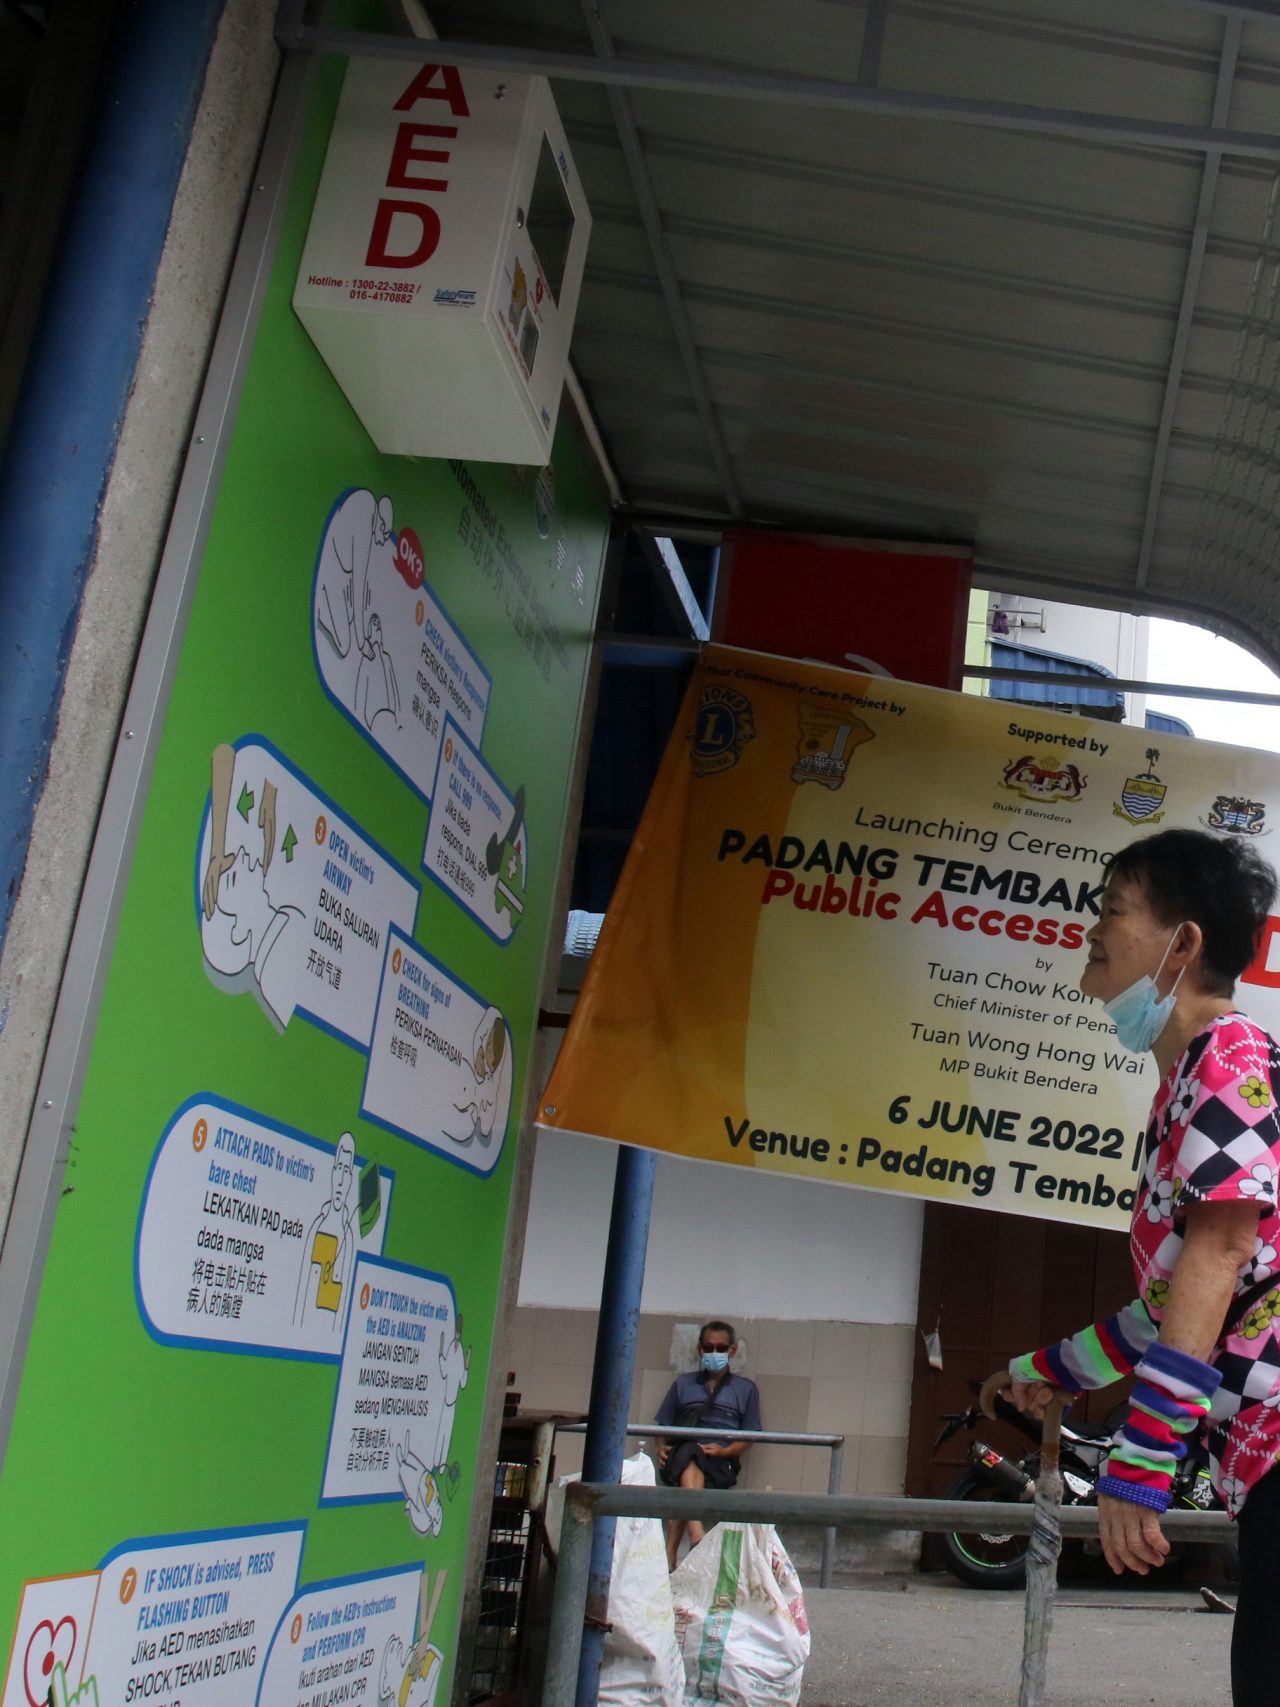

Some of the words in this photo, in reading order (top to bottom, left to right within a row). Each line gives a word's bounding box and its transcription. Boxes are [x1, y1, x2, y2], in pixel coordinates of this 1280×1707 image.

[365, 63, 471, 269] AED
[308, 275, 343, 287] Hotline
[400, 536, 423, 579] OK?
[425, 618, 445, 657] CHECK
[421, 642, 448, 687] PERIKSA
[416, 670, 441, 709] mangsa
[735, 667, 807, 693] Community
[809, 686, 840, 700] Care
[841, 692, 888, 712] Project
[889, 702, 906, 717] by
[1008, 723, 1086, 750] Supported
[1090, 738, 1109, 757] by
[449, 772, 462, 801] CALL
[462, 786, 472, 811] 999
[992, 802, 1022, 815] Bukit
[1024, 808, 1072, 825] Bendera
[854, 806, 1000, 853] Launching
[1007, 830, 1116, 867] Ceremo
[329, 830, 350, 862] OPEN
[350, 851, 375, 885] victim's
[464, 844, 477, 872] DIAL
[717, 828, 900, 881] PADANG
[912, 853, 1102, 917] TEMBAK
[323, 859, 353, 896] AIRWAY
[319, 888, 342, 922] BUKA
[343, 908, 380, 950] SALURAN
[761, 868, 902, 920] Public
[911, 890, 1086, 950] Access
[314, 916, 343, 953] UDARA
[306, 948, 342, 990] 开放气道
[402, 958, 422, 986] CHECK
[422, 973, 430, 992] for
[430, 981, 445, 1005] signs
[445, 993, 452, 1009] of
[927, 962, 978, 986] Tuan
[984, 972, 1048, 999] Chow
[1036, 957, 1054, 974] by
[398, 983, 430, 1020] BREATHING
[932, 993, 978, 1012] Chief
[980, 1000, 1050, 1025] Minister
[1053, 1011, 1072, 1027] of
[1076, 1015, 1118, 1036] Pena
[395, 1007, 422, 1039] PERIKSA
[423, 1028, 462, 1067] PERNAFASAN
[910, 1022, 962, 1047] Tuan
[967, 1030, 1032, 1061] Wong
[1036, 1041, 1097, 1072] Hong
[1102, 1052, 1146, 1076] Wai
[939, 1058, 970, 1076] MP
[974, 1062, 1020, 1084] Bukit
[1024, 1070, 1099, 1096] Bendera
[888, 1095, 912, 1125] 6
[918, 1099, 1022, 1143] JUNE
[1026, 1116, 1125, 1160] 2022
[214, 1126, 250, 1156] ATTACH
[251, 1139, 274, 1166] PADS
[275, 1149, 284, 1171] to
[284, 1151, 315, 1182] victim's
[722, 1115, 831, 1163] Venue
[856, 1137, 997, 1197] Padang
[1008, 1160, 1138, 1213] Temba
[208, 1160, 230, 1188] bare
[232, 1168, 257, 1195] chest
[203, 1191, 259, 1227] LEKATKAN
[260, 1207, 280, 1232] PAD
[280, 1215, 303, 1239] pada
[197, 1225, 224, 1252] dada
[225, 1236, 264, 1264] mangsa
[191, 1257, 267, 1296] 将电击贴片贴在
[186, 1287, 243, 1319] 病人的胸膛
[370, 1288, 389, 1307] DON'T
[390, 1292, 409, 1313] TOUCH
[410, 1296, 418, 1313] the
[419, 1299, 435, 1318] victim
[366, 1317, 376, 1333] the
[377, 1319, 390, 1336] AED
[396, 1321, 426, 1342] ANALYZING
[362, 1340, 392, 1361] JANGAN
[392, 1343, 420, 1365] SENTUH
[358, 1368, 390, 1388] MANGSA
[390, 1373, 414, 1390] semasa
[414, 1374, 428, 1391] AED
[354, 1399, 380, 1419] sedang
[381, 1398, 428, 1417] MENGANALISIS
[144, 1569, 157, 1594] IF
[158, 1563, 195, 1592] SHOCK
[194, 1562, 204, 1585] is
[205, 1556, 242, 1584] advised,
[246, 1551, 276, 1576] PRESS
[136, 1598, 190, 1631] FLASHING
[191, 1591, 230, 1620] BUTTON
[306, 1611, 330, 1632] Follow
[330, 1608, 342, 1626] the
[362, 1594, 397, 1618] instructions
[132, 1638, 157, 1665] Jika
[158, 1631, 184, 1658] AED
[186, 1618, 255, 1651] menasihatkan
[302, 1640, 318, 1662] and
[318, 1631, 352, 1658] PERFORM
[352, 1626, 366, 1648] CPR
[213, 1645, 256, 1678] BUTANG
[316, 1661, 342, 1684] arahan
[359, 1648, 374, 1668] AED
[351, 1677, 368, 1700] CPR
